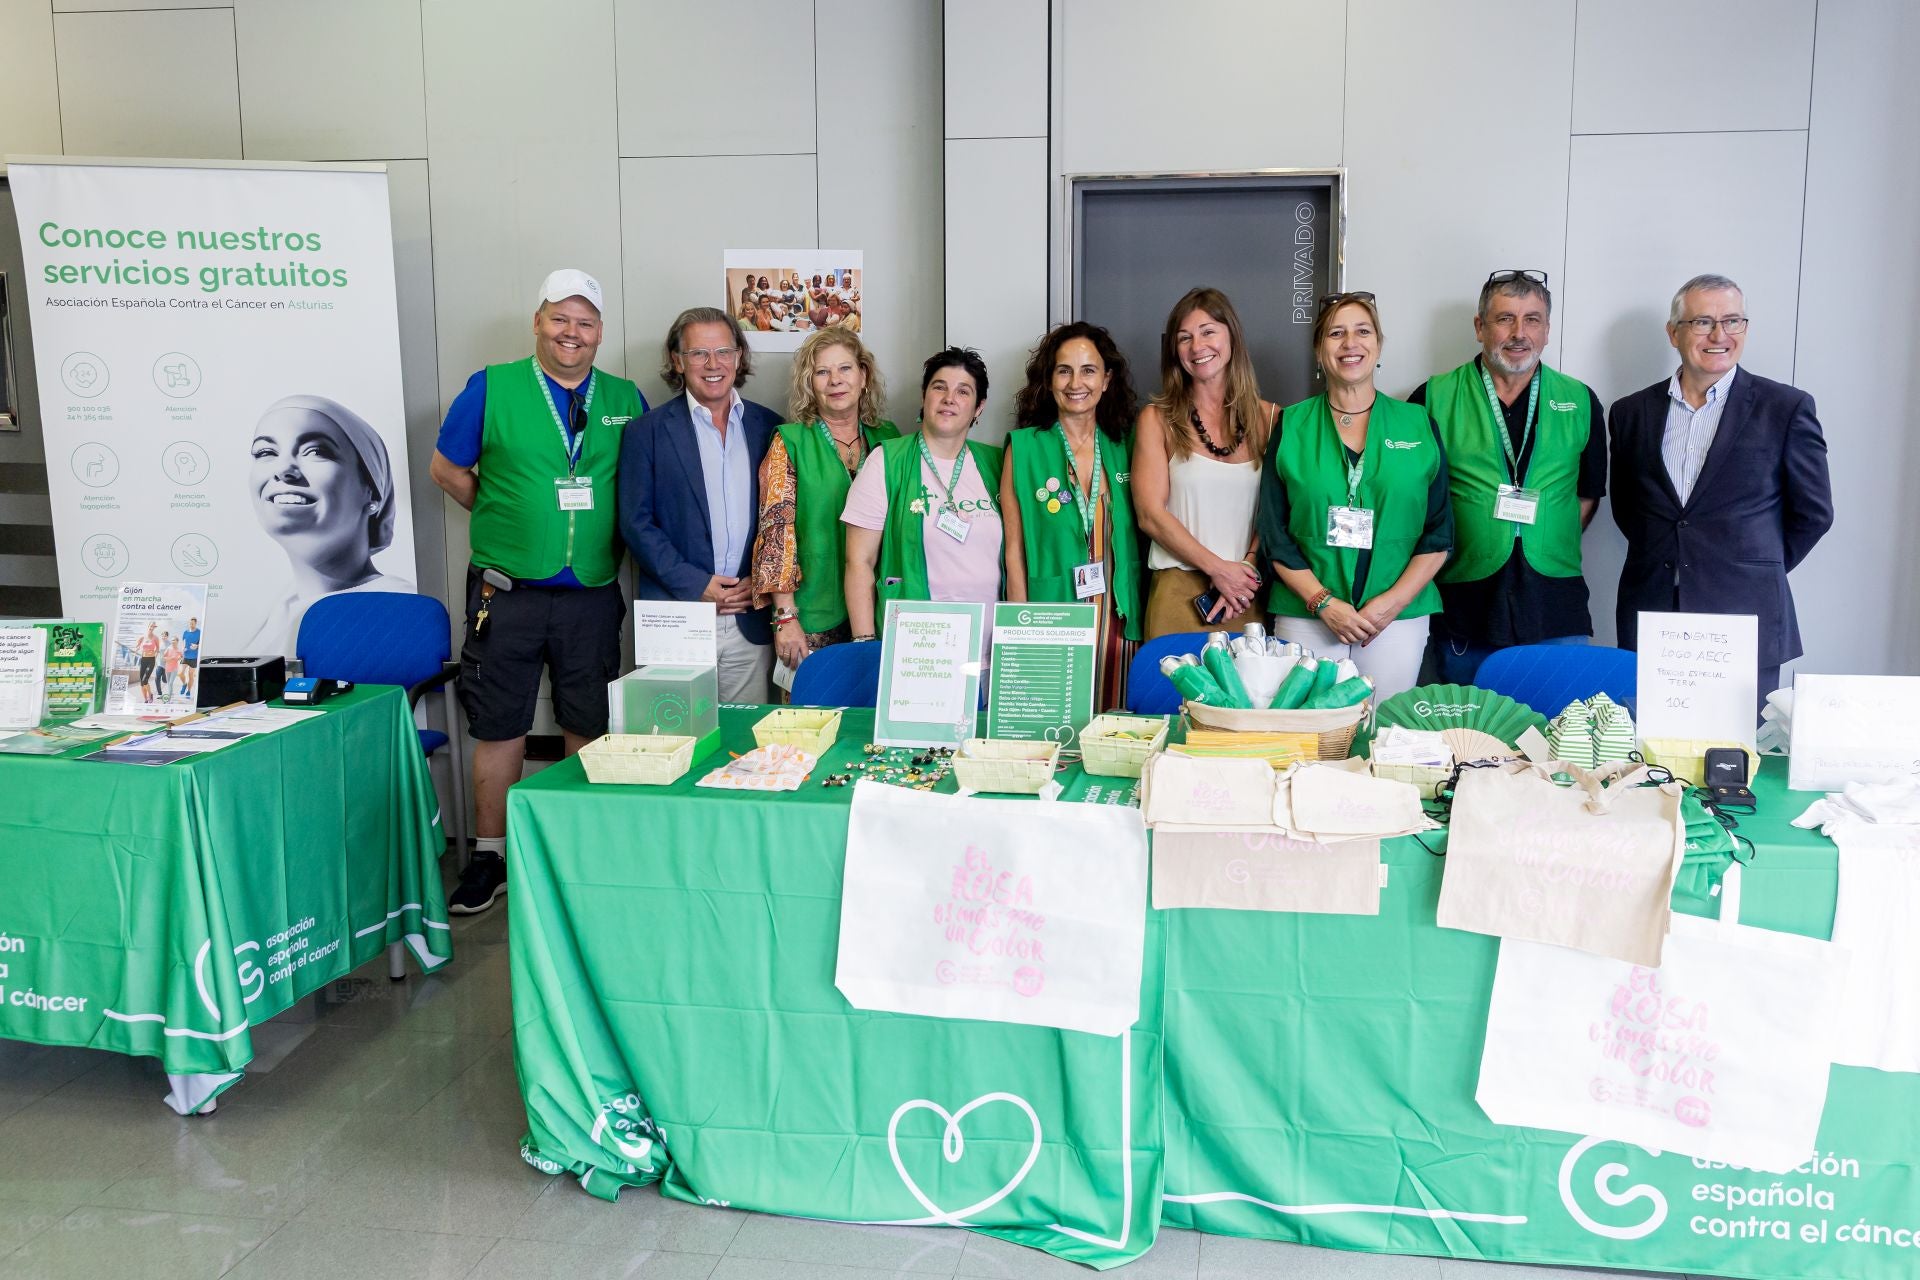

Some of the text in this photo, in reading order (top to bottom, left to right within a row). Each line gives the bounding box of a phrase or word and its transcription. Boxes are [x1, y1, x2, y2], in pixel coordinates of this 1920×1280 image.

[39, 222, 322, 251] Conoce nuestros
[1292, 202, 1316, 324] PRIVADO
[43, 258, 348, 292] servicios gratuitos
[46, 297, 334, 310] Asociación Española Contra el Cáncer en Asturias
[171, 413, 193, 421] social
[124, 586, 142, 595] Gijón
[900, 621, 951, 629] PENDIENTES
[1659, 630, 1728, 644] PENDIENTES
[902, 657, 934, 665] HECHOS
[1661, 648, 1732, 663] LOGO AECC
[901, 671, 952, 679] VOLUNTARIA
[1688, 669, 1726, 679] ESPECIAL
[1665, 697, 1690, 709] 10€
[965, 845, 993, 871] EL
[951, 864, 1033, 905] ROSA
[297, 952, 307, 968] el
[308, 939, 340, 963] cáncer
[10, 987, 88, 1013] cáncer
[1611, 984, 1708, 1031] ROSA
[1691, 1182, 1835, 1211] española
[1690, 1215, 1790, 1240] contra
[1800, 1219, 1827, 1243] el
